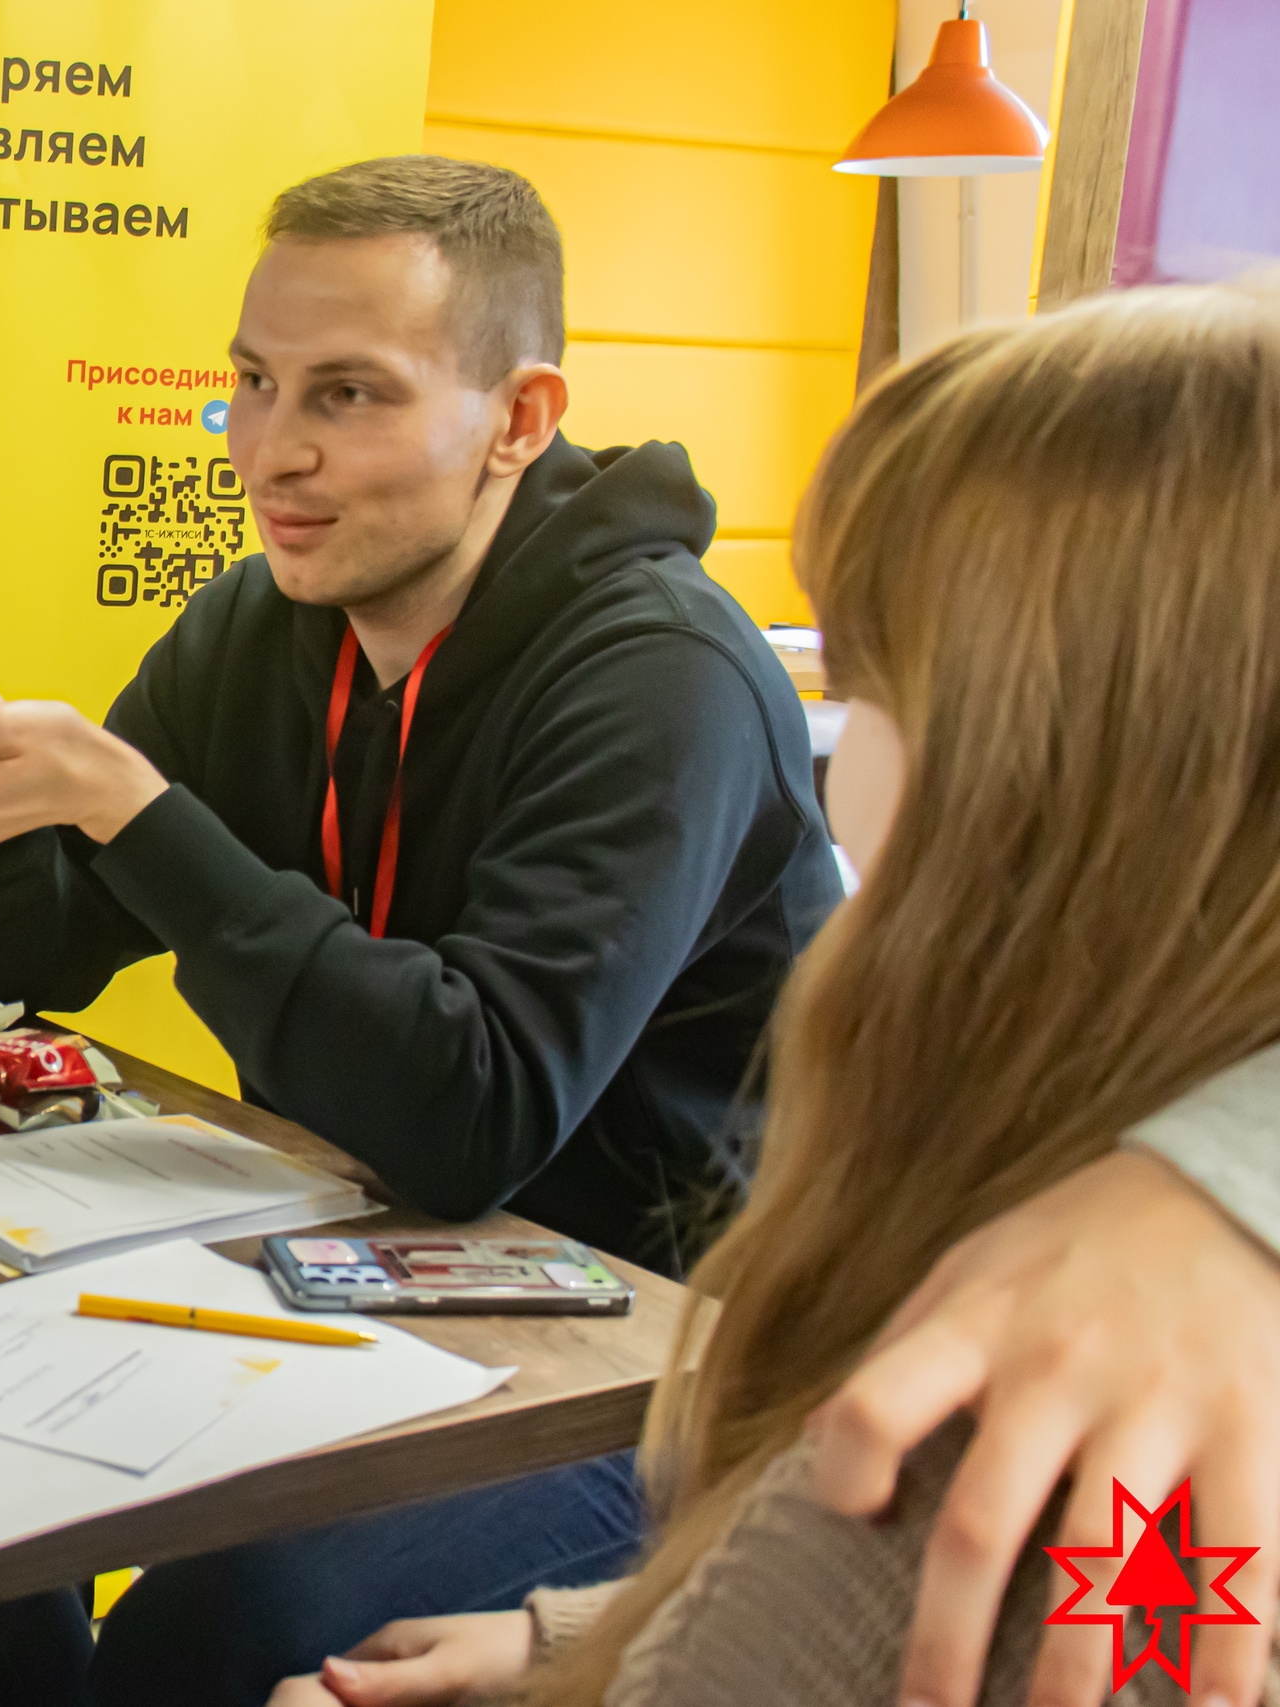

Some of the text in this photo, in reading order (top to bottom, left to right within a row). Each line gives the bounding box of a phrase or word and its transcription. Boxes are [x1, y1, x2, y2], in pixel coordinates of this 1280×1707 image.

[66, 359, 238, 391] Присоединя
[117, 406, 193, 426] к нам
[144, 529, 202, 540] 1С-ИЖТИСИ
